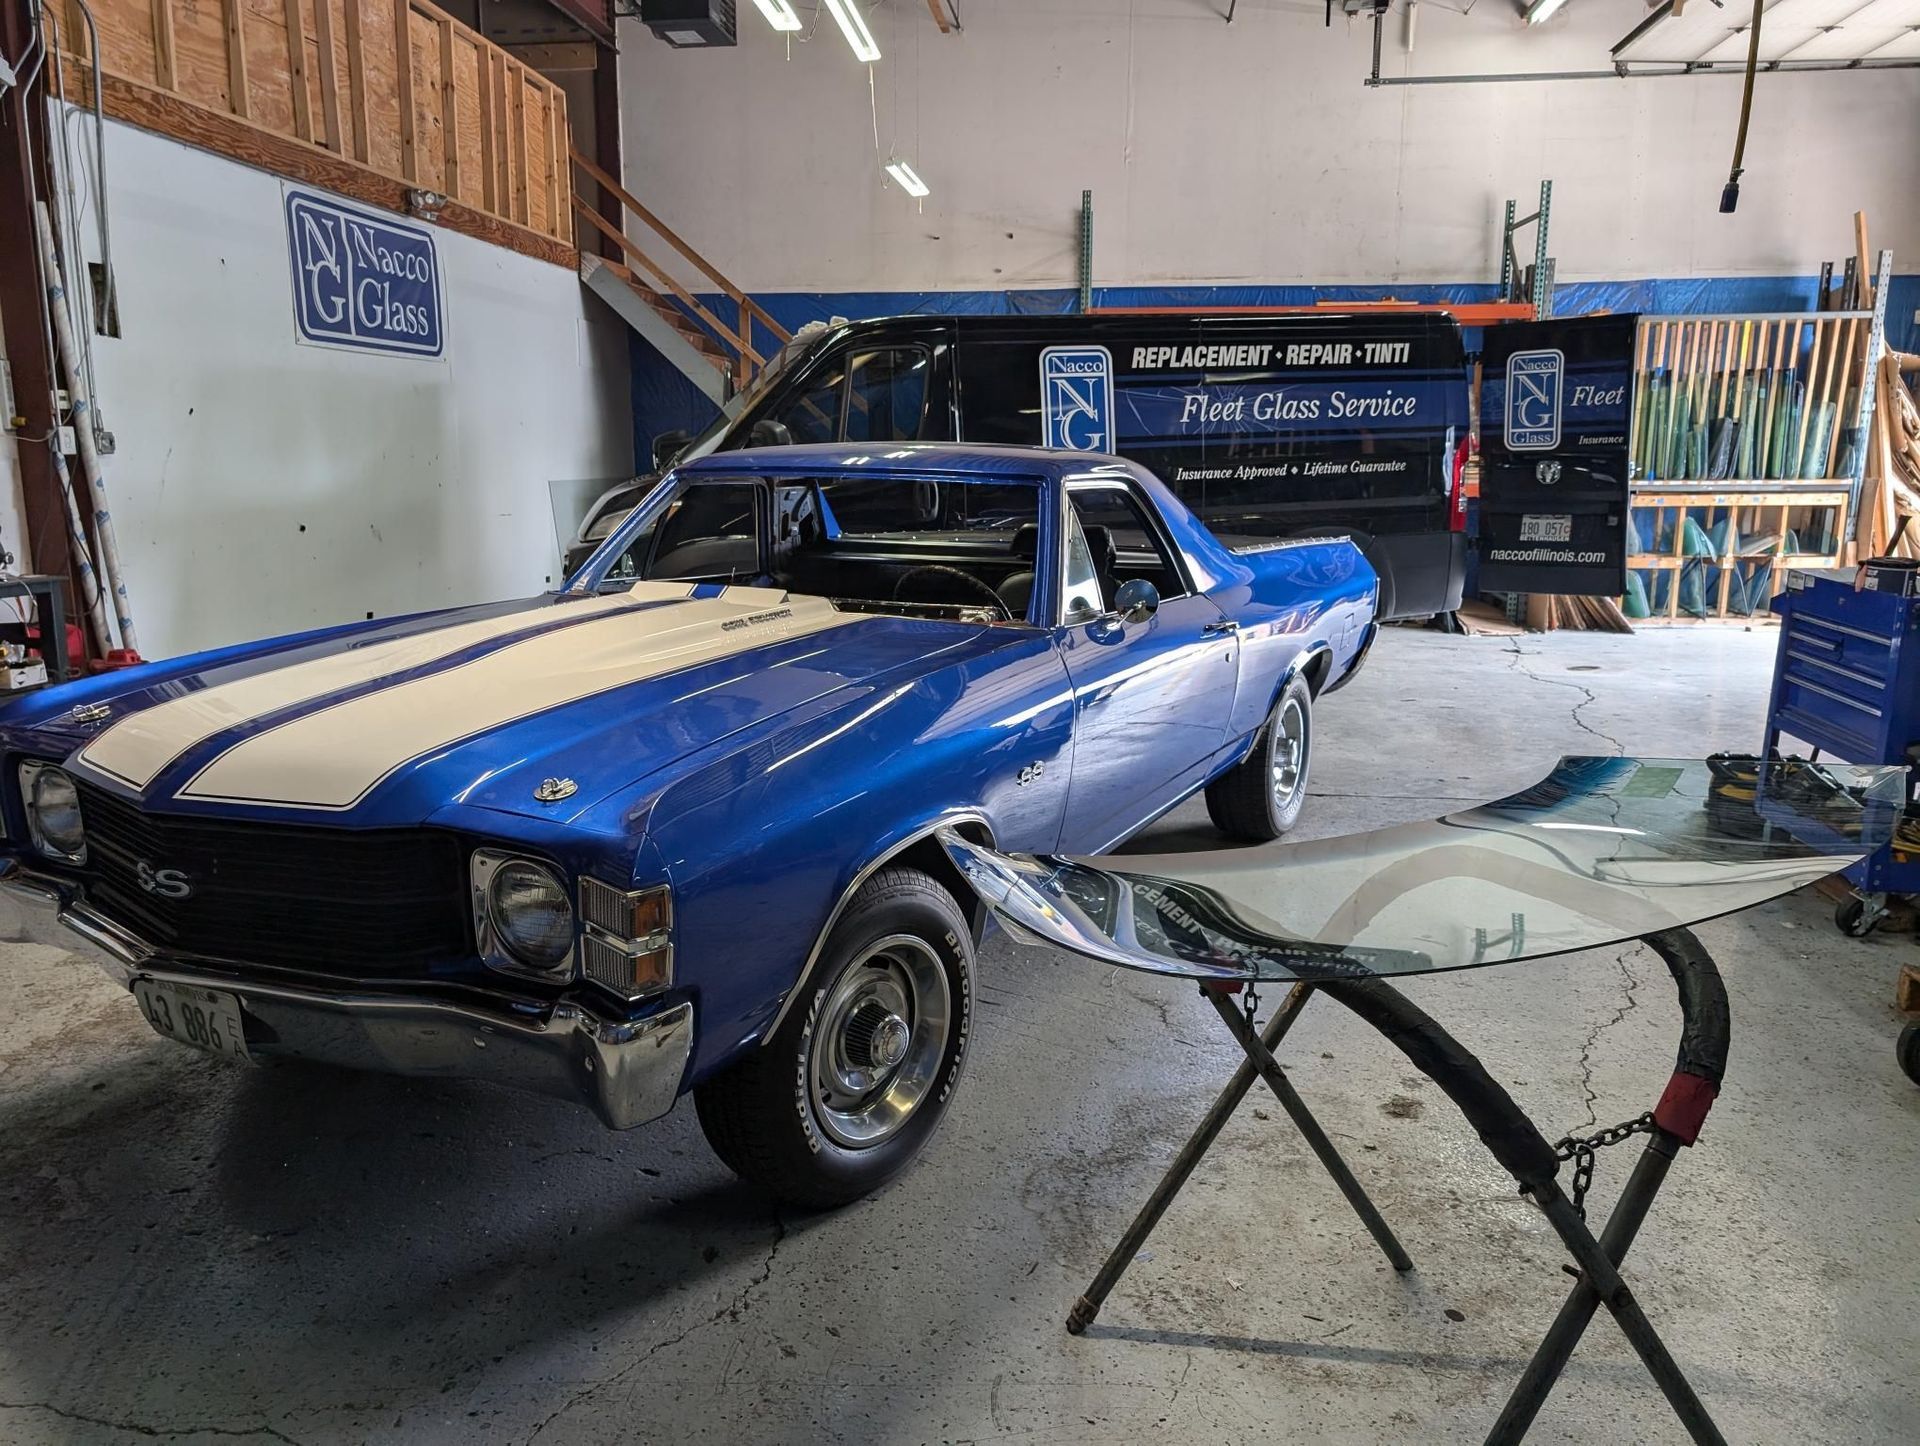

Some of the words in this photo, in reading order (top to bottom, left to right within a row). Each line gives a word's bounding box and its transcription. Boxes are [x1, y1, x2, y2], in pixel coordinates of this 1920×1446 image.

[349, 223, 429, 284] Nacco
[357, 278, 429, 337] Glass
[1051, 357, 1103, 373] Nacco
[1131, 345, 1273, 369] REPLACEMENT
[1285, 343, 1353, 366] REPAIR
[1364, 342, 1410, 364] TINTI
[1516, 358, 1557, 371] Nacco
[1180, 394, 1244, 423] Fleet
[1253, 391, 1321, 421] Glass
[1328, 389, 1417, 418] Service
[1570, 385, 1625, 407] Fleet
[1513, 432, 1552, 444] Glass
[1579, 435, 1625, 446] Insurance
[1176, 467, 1233, 481] Insurance
[1234, 463, 1288, 481] Approved
[1302, 461, 1349, 477] Lifetime
[1350, 459, 1407, 474] Guarantee
[1490, 547, 1606, 564] naccoofillinois.com
[136, 860, 192, 898] SS
[180, 1001, 224, 1050] 886
